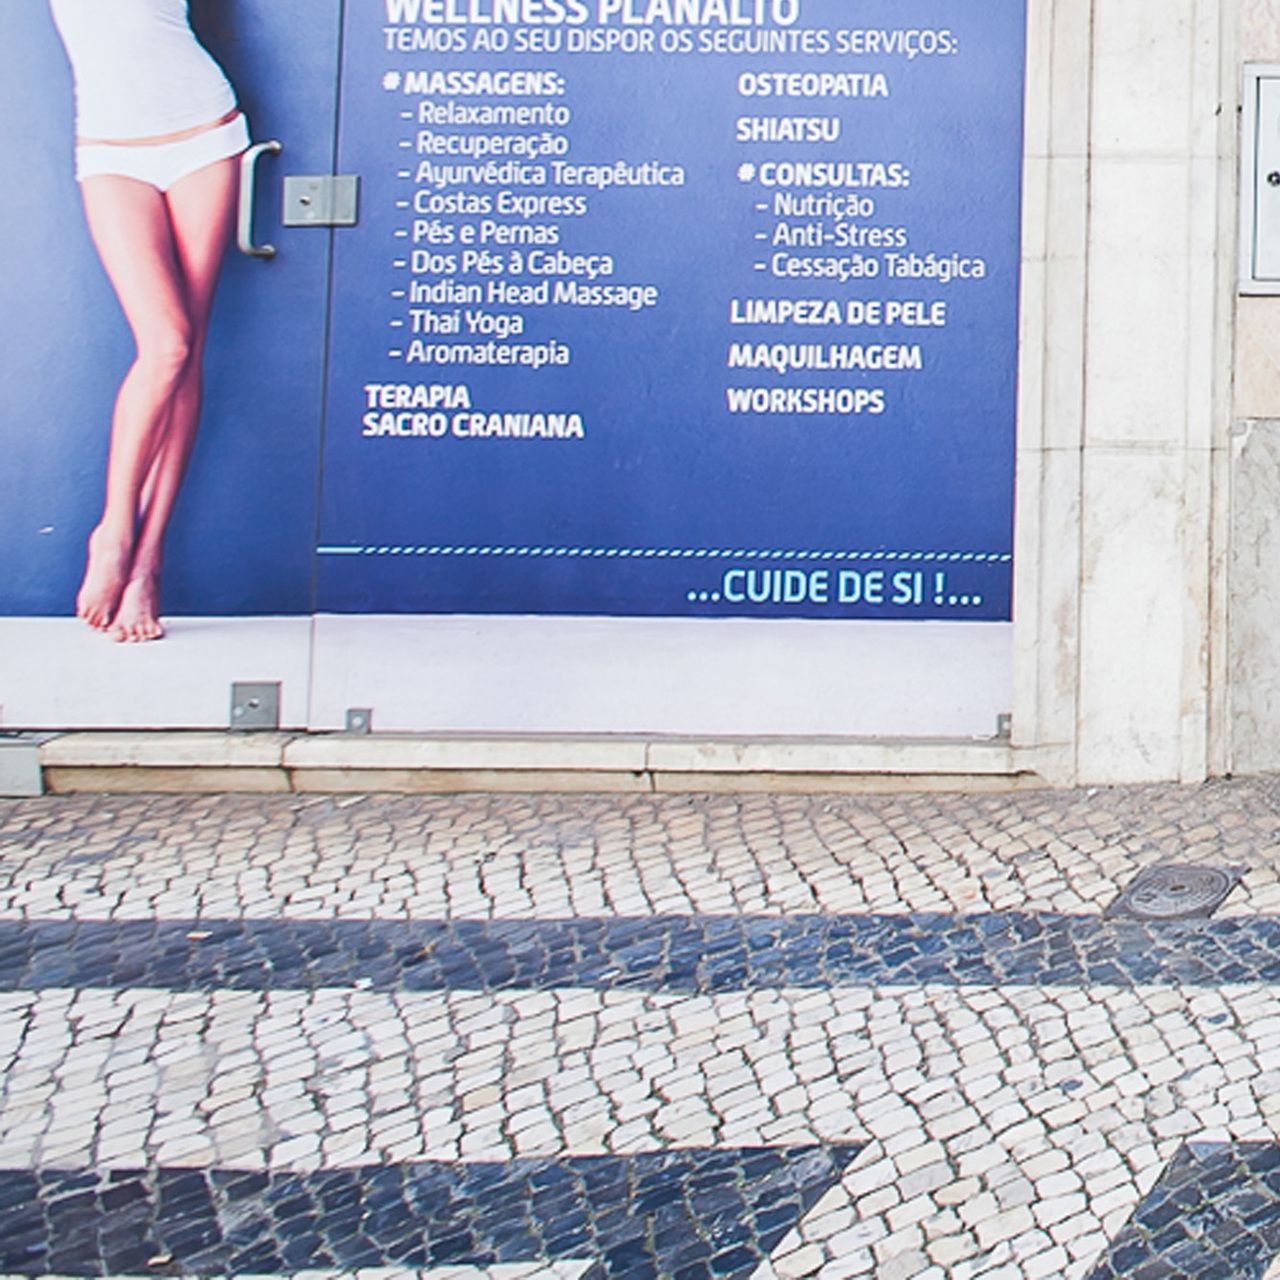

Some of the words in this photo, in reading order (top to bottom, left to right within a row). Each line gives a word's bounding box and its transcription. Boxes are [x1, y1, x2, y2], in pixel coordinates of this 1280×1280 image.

[382, 27, 467, 52] TEMOS
[471, 27, 509, 52] AO
[513, 27, 562, 52] SEU
[567, 28, 655, 53] DISPOR
[659, 28, 694, 53] OS
[698, 28, 831, 54] SEGUINTES
[835, 29, 958, 59] SERVIÇOS:
[403, 71, 565, 95] MASSAGENS:
[738, 72, 889, 97] OSTEOPATIA
[418, 100, 570, 126] Relaxamento
[736, 117, 840, 142] SHIATSU
[416, 129, 569, 160] Recuperação
[414, 160, 546, 190] Ayurvédica
[550, 160, 685, 190] Terapêutica
[759, 162, 910, 187] CONSULTAS:
[413, 189, 492, 214] Costas
[496, 190, 587, 219] Express
[774, 191, 874, 222] Nutrição
[412, 219, 455, 244] Pés
[459, 225, 475, 244] e
[480, 219, 559, 245] Pernas
[772, 222, 907, 247] Anti-Stress
[411, 249, 457, 274] Dos
[461, 250, 504, 275] Pés
[507, 250, 523, 275] à
[527, 250, 613, 280] Cabeça
[771, 252, 879, 283] Cessação
[883, 253, 985, 283] Tabágica
[409, 279, 482, 304] Indian
[487, 280, 549, 305] Head
[552, 281, 658, 311] Massage
[464, 310, 523, 339] Yoga
[730, 299, 842, 325] LIMPEZA
[846, 301, 881, 325] DE
[885, 301, 946, 326] PELE
[406, 339, 570, 369] Aromaterapia
[727, 343, 922, 374] MAQUILHAGEM
[363, 384, 471, 409] TERAPIA
[726, 388, 885, 414] WORKSHOPS
[362, 412, 448, 437] SACRO
[451, 412, 584, 438] CRANIANA
[838, 570, 884, 603] DE
[892, 572, 922, 605] SI
